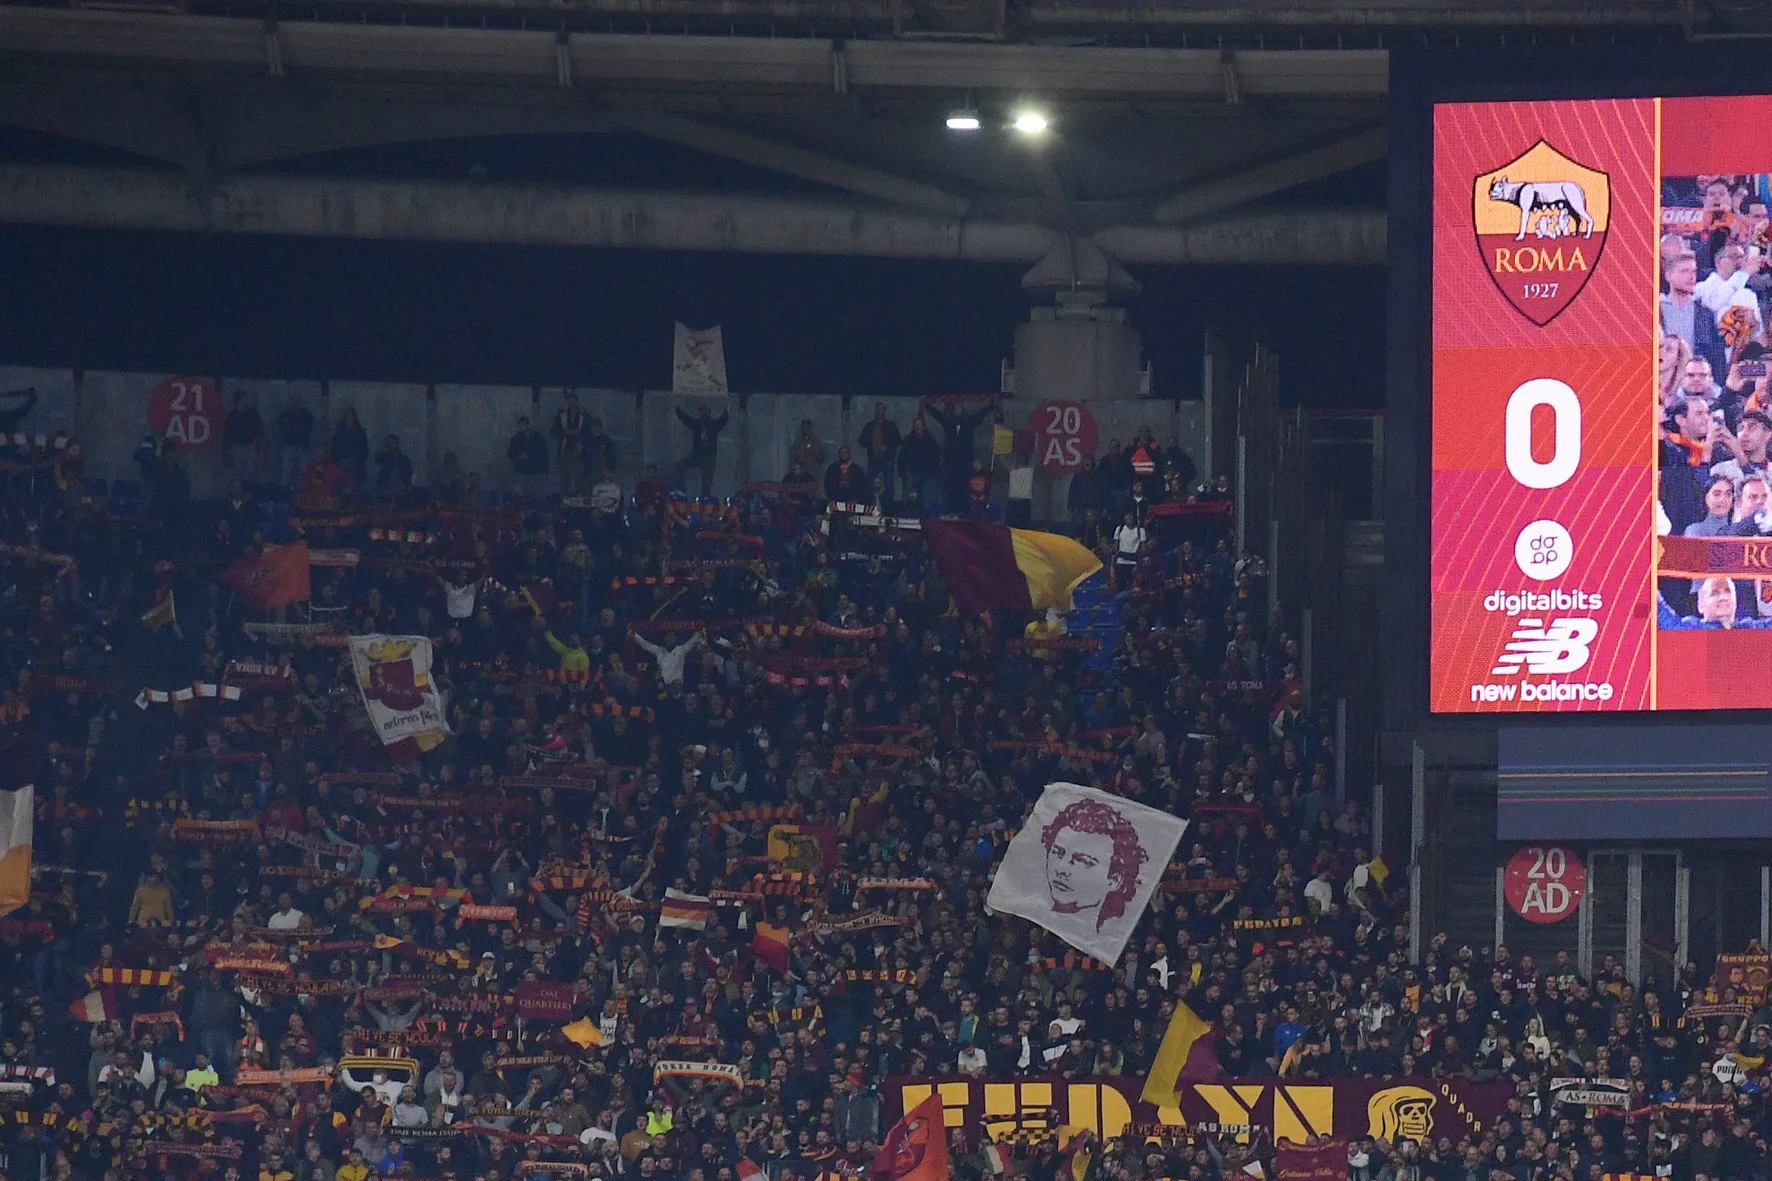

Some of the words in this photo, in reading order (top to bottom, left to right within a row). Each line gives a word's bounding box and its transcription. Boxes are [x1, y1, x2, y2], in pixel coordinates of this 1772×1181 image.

[1494, 246, 1588, 273] ROMA
[1523, 282, 1559, 298] 1927
[169, 382, 203, 412] 21
[165, 416, 211, 445] AD
[1046, 406, 1081, 434] 20
[1505, 377, 1582, 489] 0
[1043, 438, 1081, 468] AS
[1484, 589, 1603, 616] digitalbits
[1471, 685, 1516, 701] new
[1521, 680, 1613, 702] balance
[1528, 847, 1566, 880] 20
[1521, 881, 1571, 914] AD
